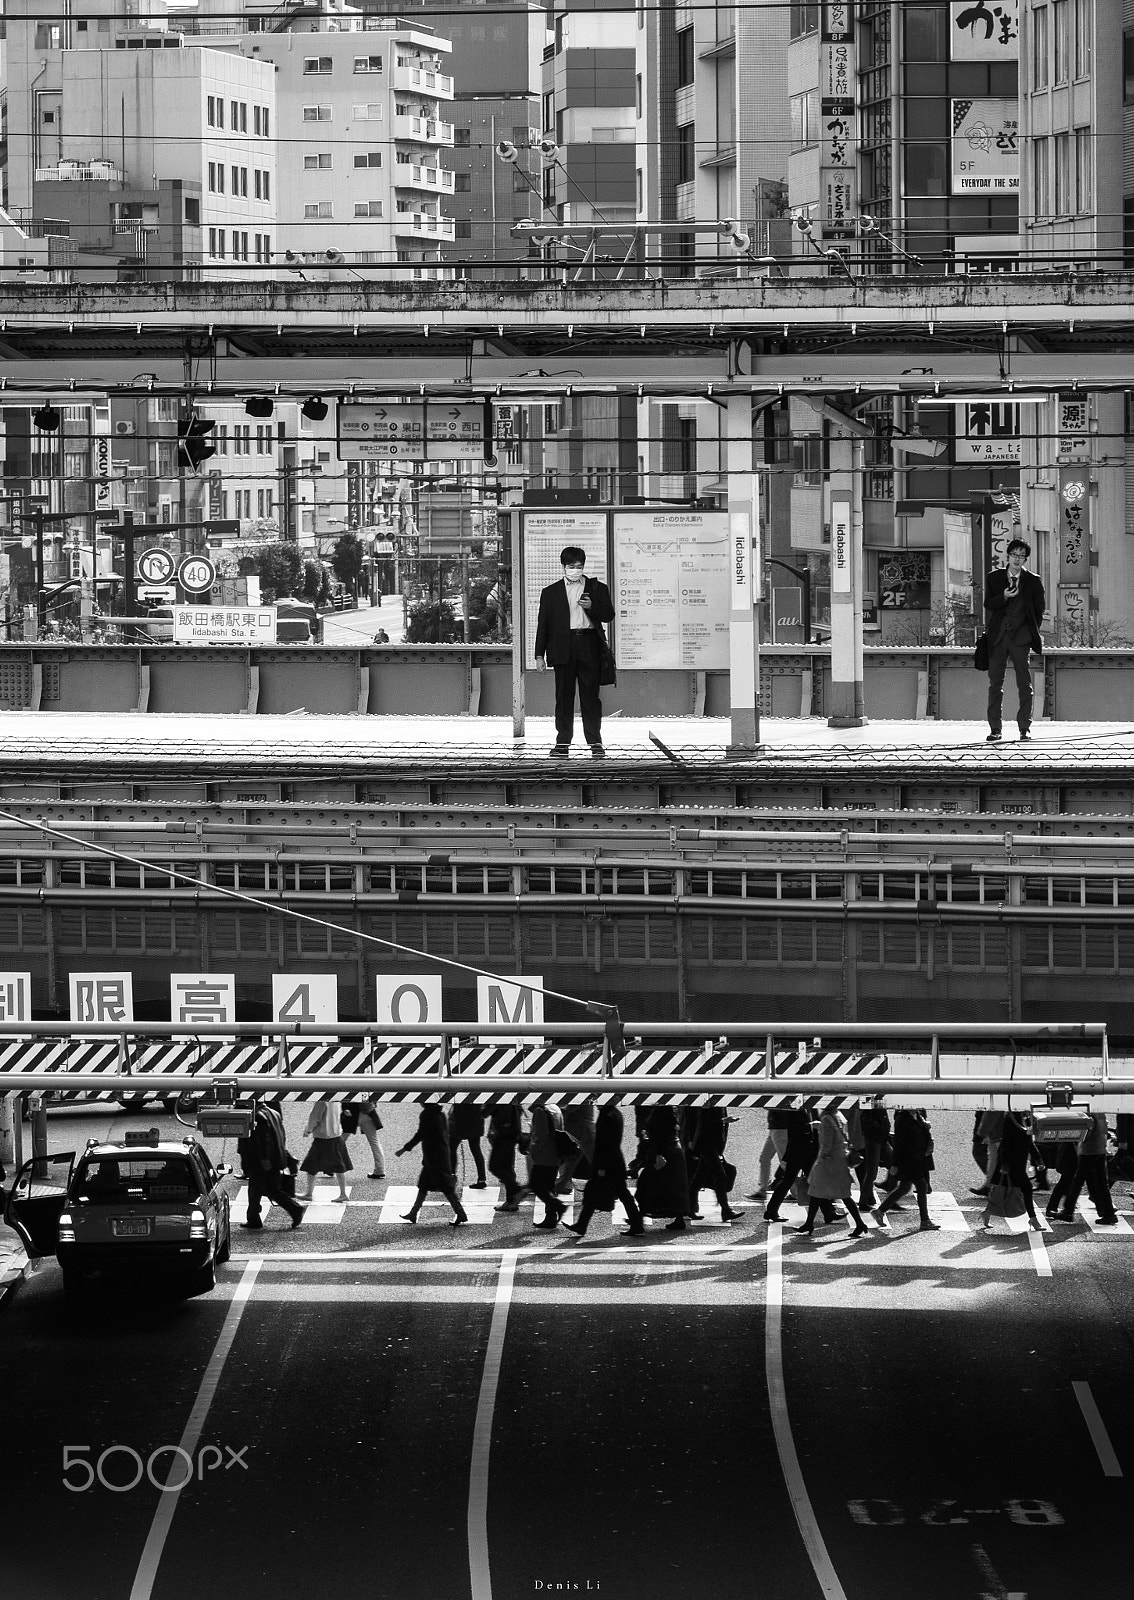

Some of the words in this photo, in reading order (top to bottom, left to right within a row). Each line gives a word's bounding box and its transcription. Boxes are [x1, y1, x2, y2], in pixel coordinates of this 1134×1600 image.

[831, 33, 845, 41] 8F
[832, 106, 844, 116] 6F
[960, 161, 975, 171] 5F
[961, 178, 991, 188] EVERYDAY
[994, 178, 1006, 188] THE
[1062, 404, 1080, 422] 源
[402, 422, 421, 433] 東口
[462, 422, 481, 432] 西口
[836, 523, 847, 569] Iidabashi
[735, 537, 746, 585] Iidabashi
[187, 566, 207, 583] 40
[882, 591, 906, 606] 2F
[178, 611, 272, 628] 飯田橋駅東口
[777, 617, 799, 626] au
[192, 628, 228, 637] Iidabashi
[231, 629, 247, 637] Sta.
